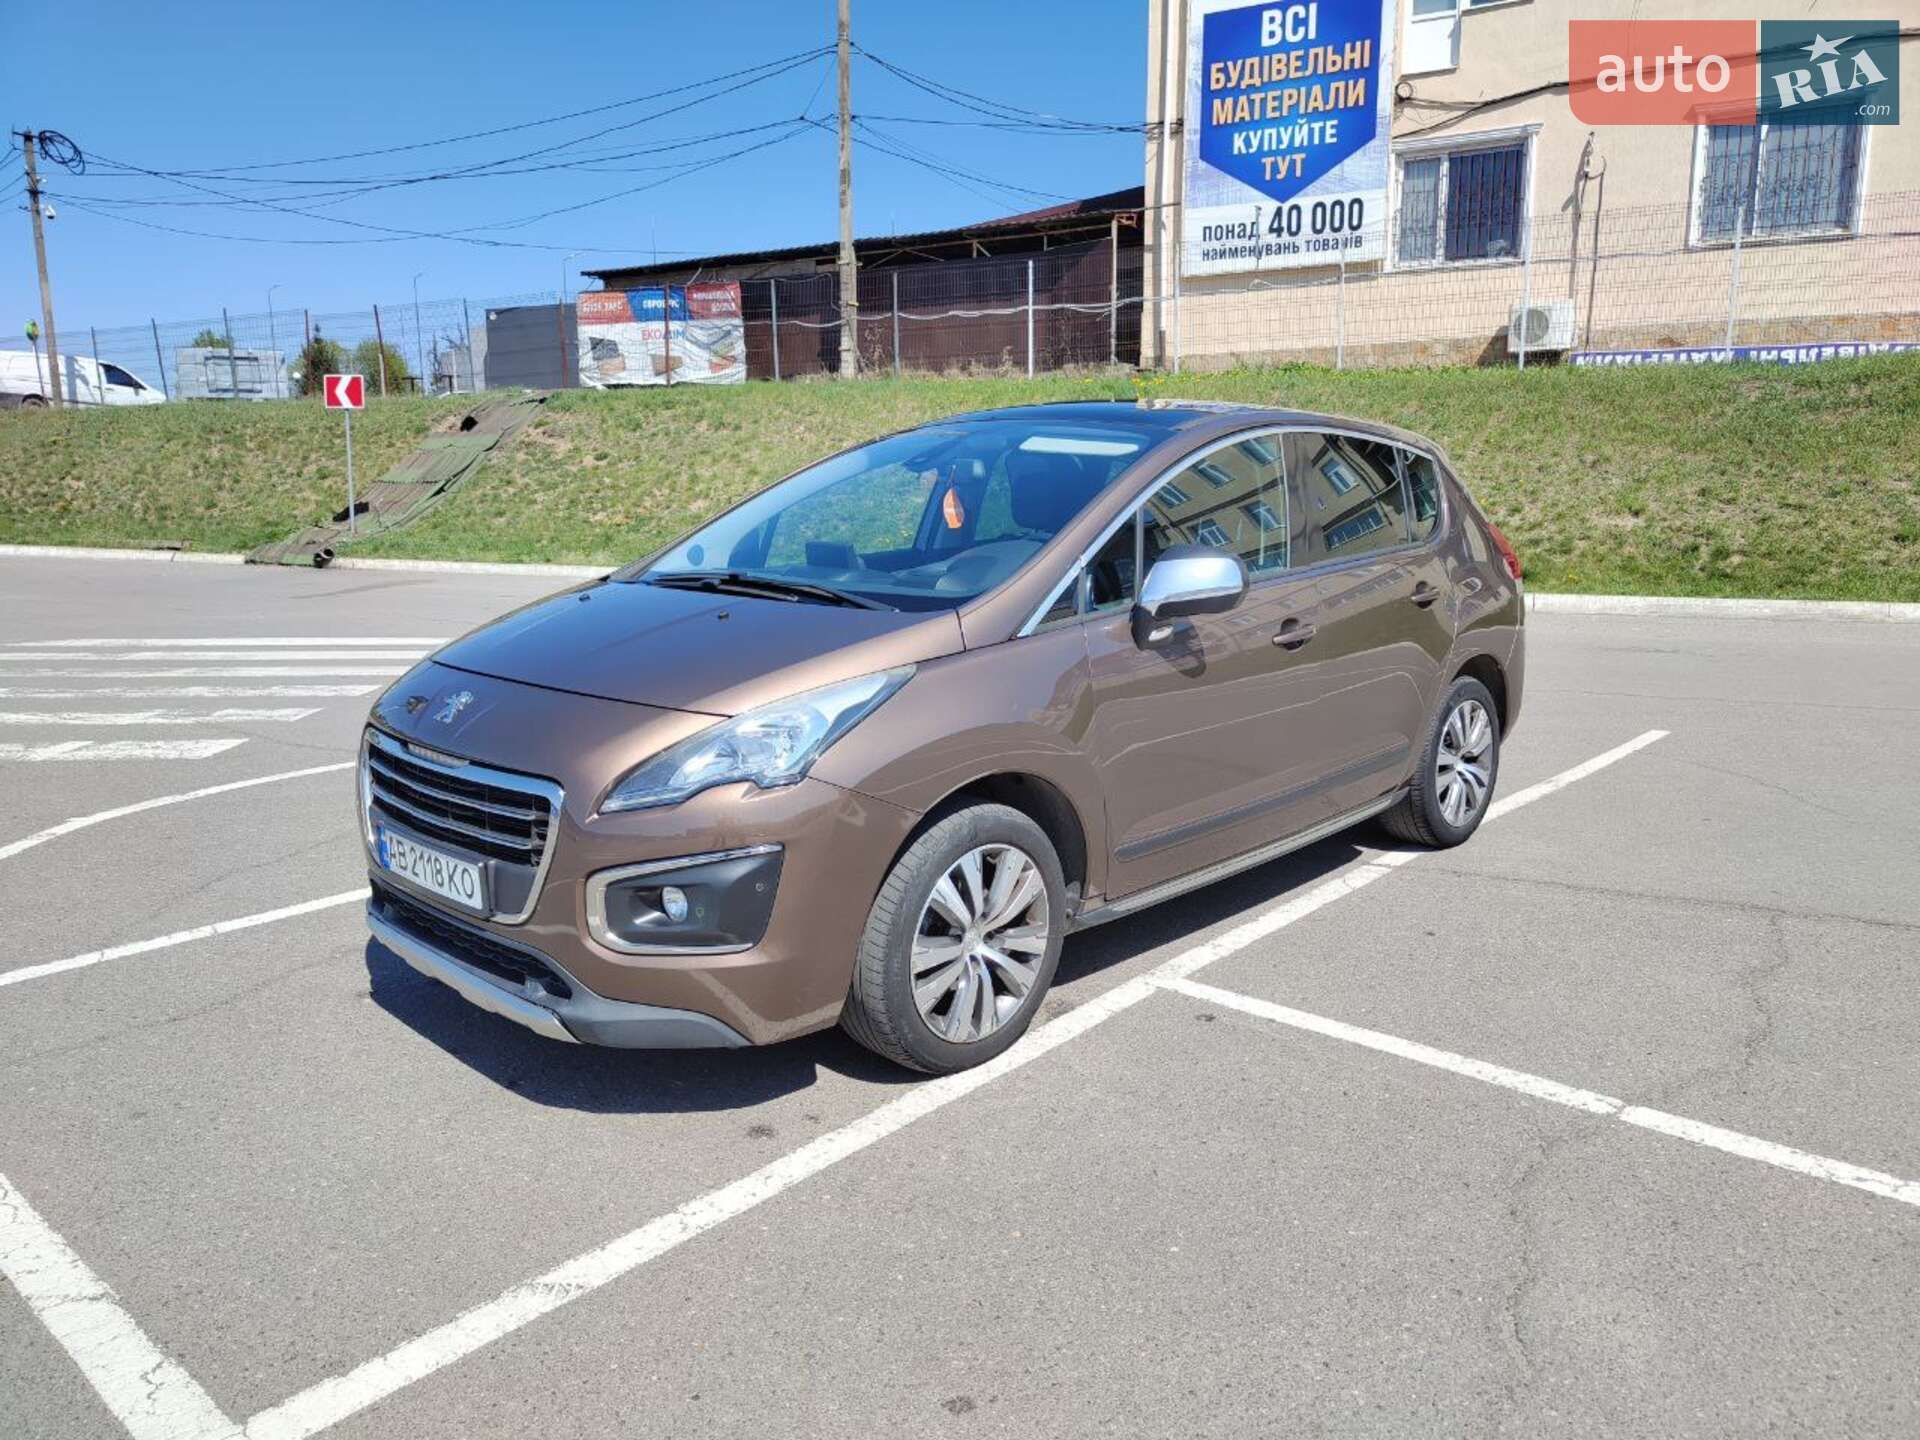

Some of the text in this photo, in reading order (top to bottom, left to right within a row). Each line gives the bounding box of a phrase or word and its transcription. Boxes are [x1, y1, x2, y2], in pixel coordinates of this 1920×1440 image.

[1261, 3, 1318, 47] ВСІ
[1210, 39, 1371, 91] БУДІВЕЛЬНІ
[1212, 78, 1365, 126] МАТЕРІАЛИ
[1233, 119, 1339, 155] КУПУЙТЕ
[1262, 153, 1306, 181] ТУТ
[1202, 197, 1364, 242] понад 40 000
[1202, 243, 1300, 262] найменувань
[409, 845, 444, 887] 2118
[446, 861, 475, 899] KO
